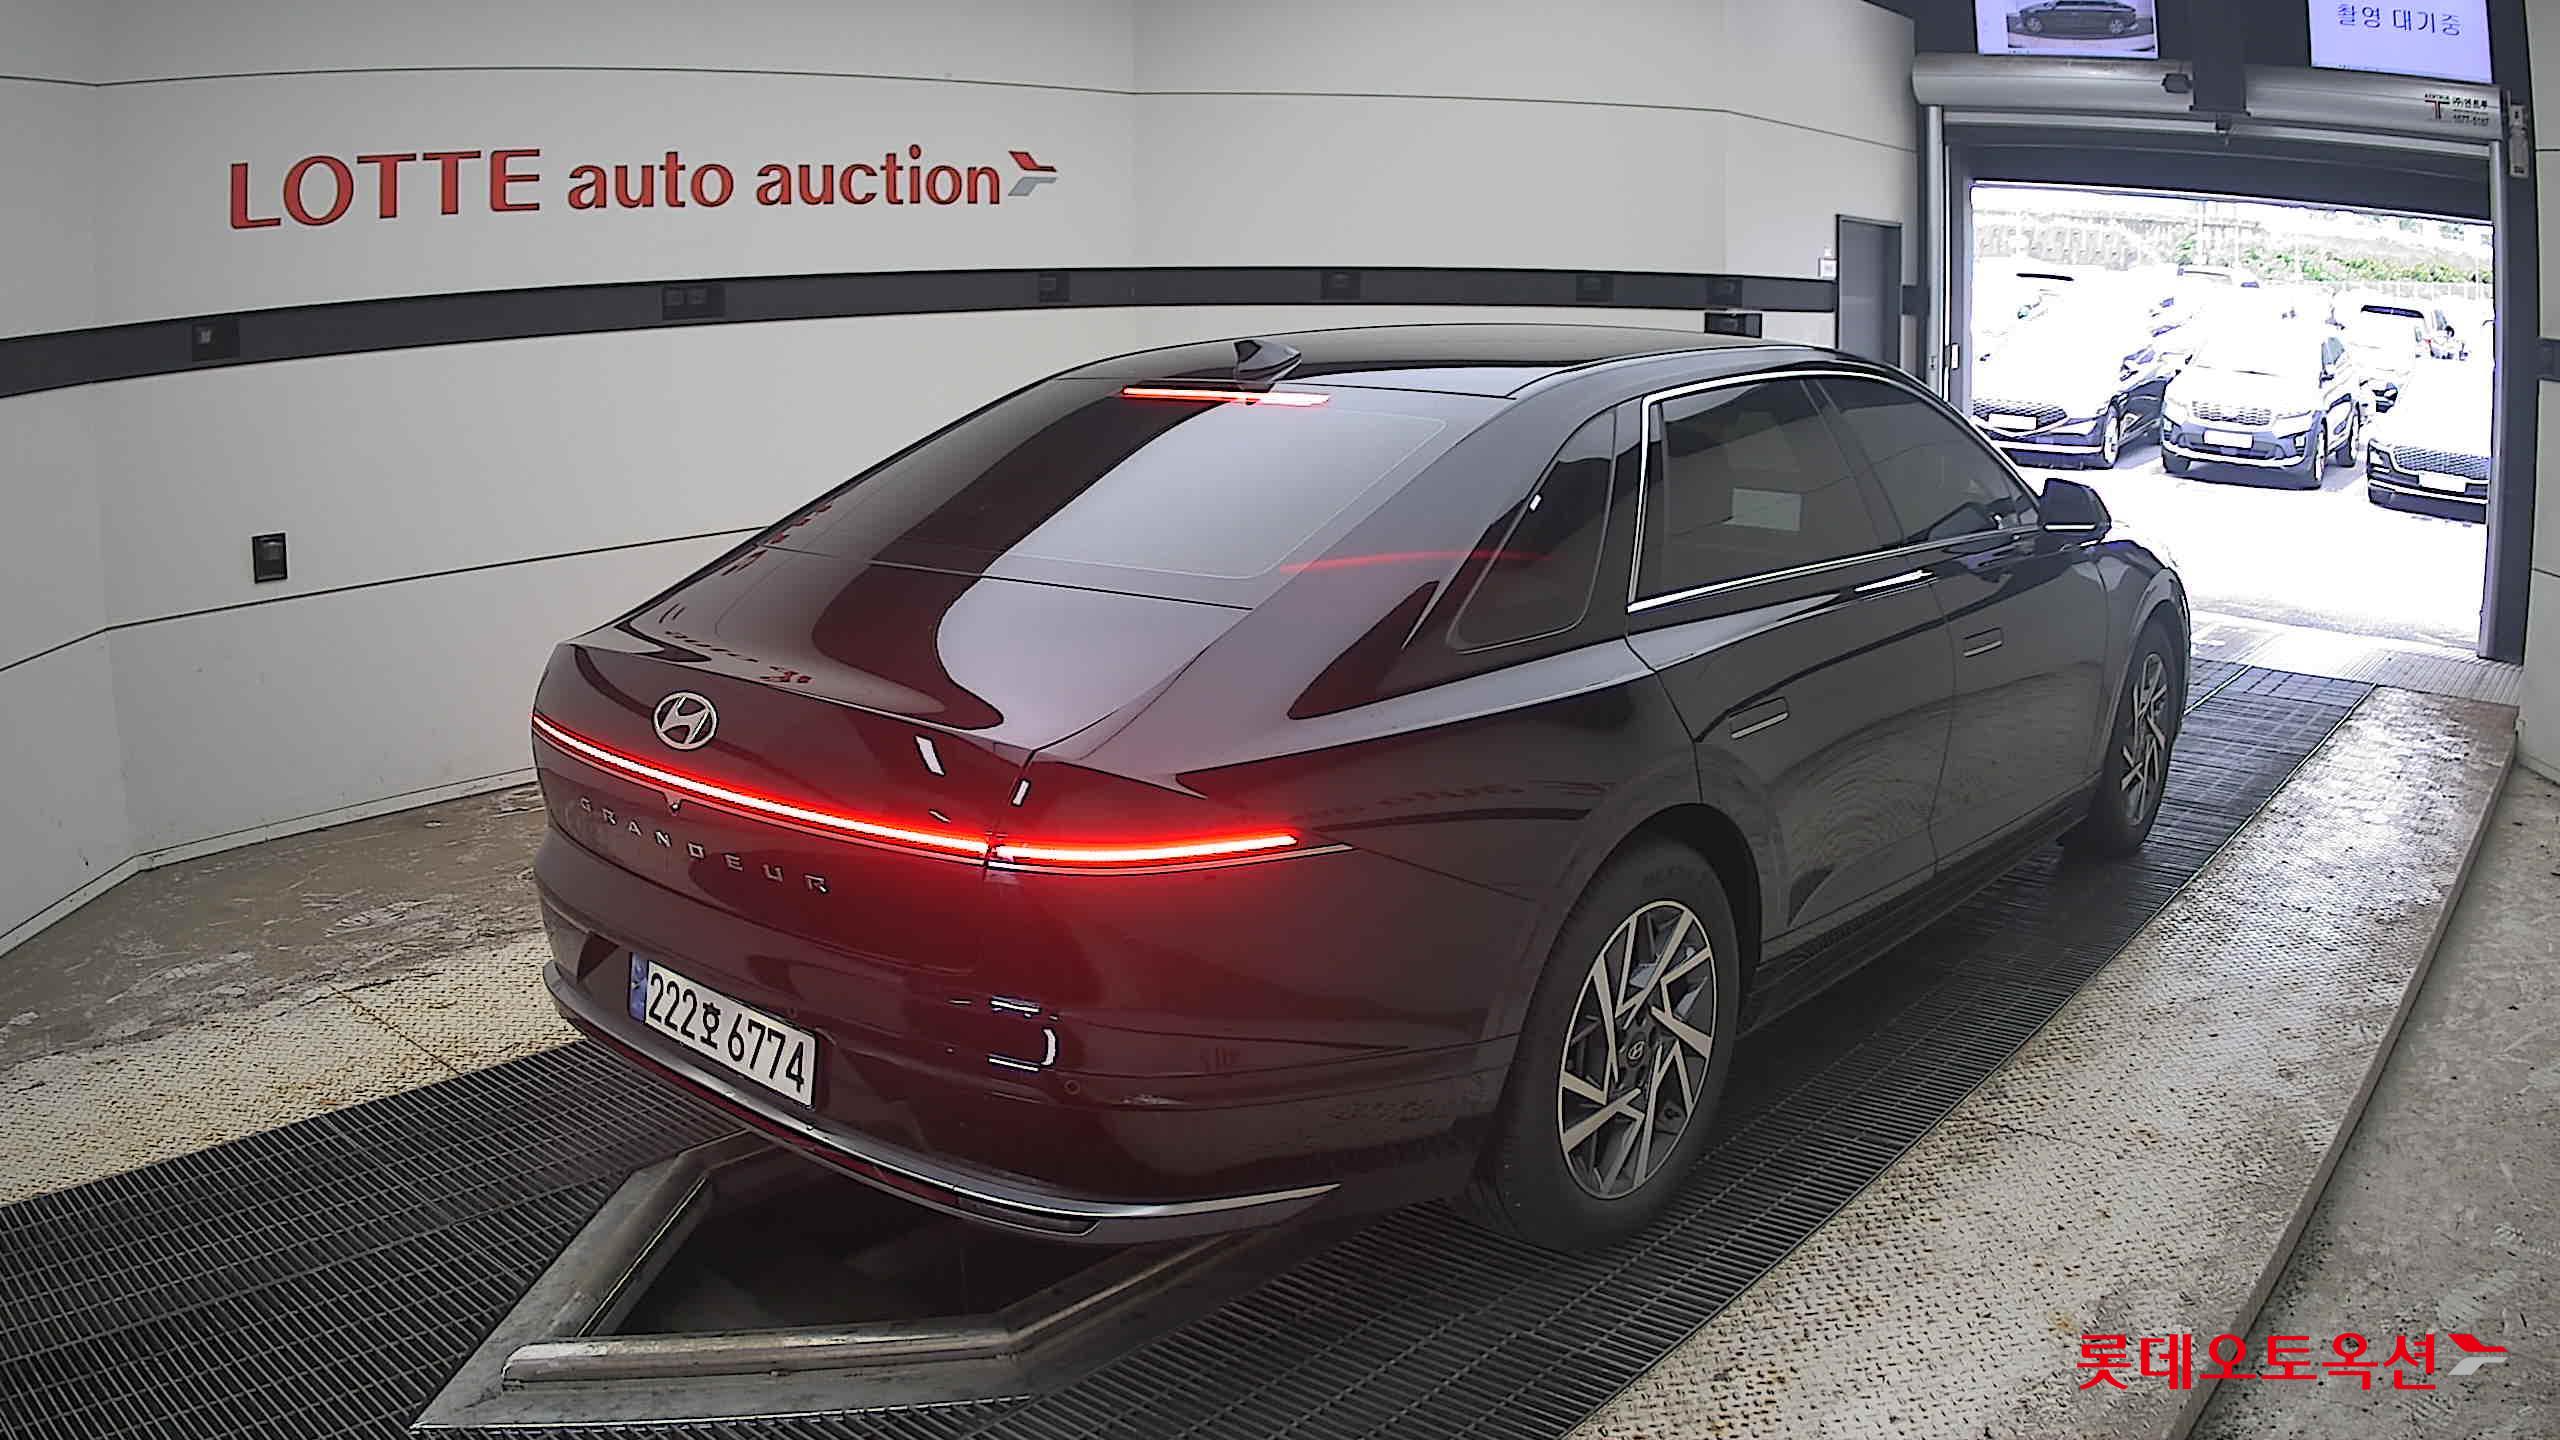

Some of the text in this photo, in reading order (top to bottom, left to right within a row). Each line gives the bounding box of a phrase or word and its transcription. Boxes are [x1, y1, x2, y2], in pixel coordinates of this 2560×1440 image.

[2337, 3, 2461, 36] 촬영 대기중
[229, 144, 1001, 230] LOTTE auto auction
[580, 797, 829, 894] GRANDEUR
[727, 1012, 805, 1094] 6774
